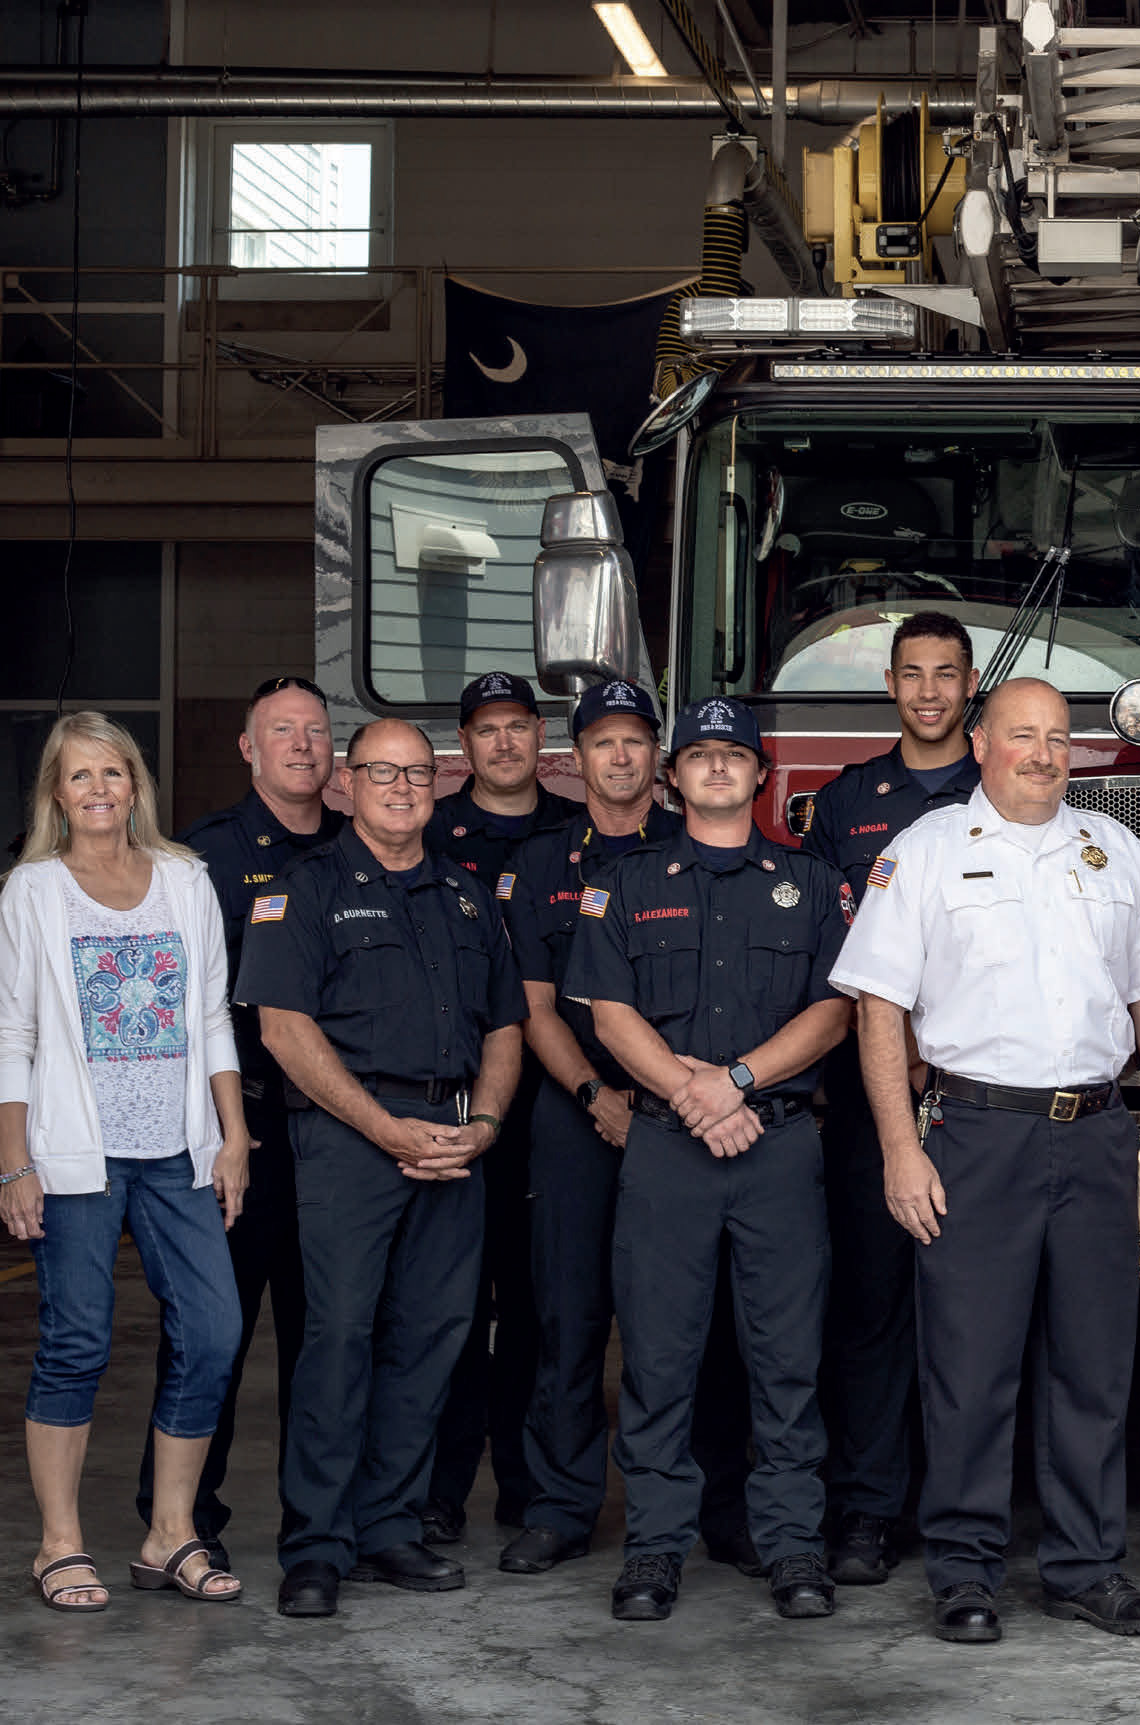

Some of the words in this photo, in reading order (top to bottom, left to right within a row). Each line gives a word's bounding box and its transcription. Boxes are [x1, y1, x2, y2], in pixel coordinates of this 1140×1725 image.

[847, 506, 880, 515] E-ONE
[850, 827, 857, 836] S.
[859, 823, 888, 834] HOGAN
[334, 914, 343, 923] D.
[344, 909, 388, 919] BURNETTE
[642, 908, 689, 920] ALEXANDER
